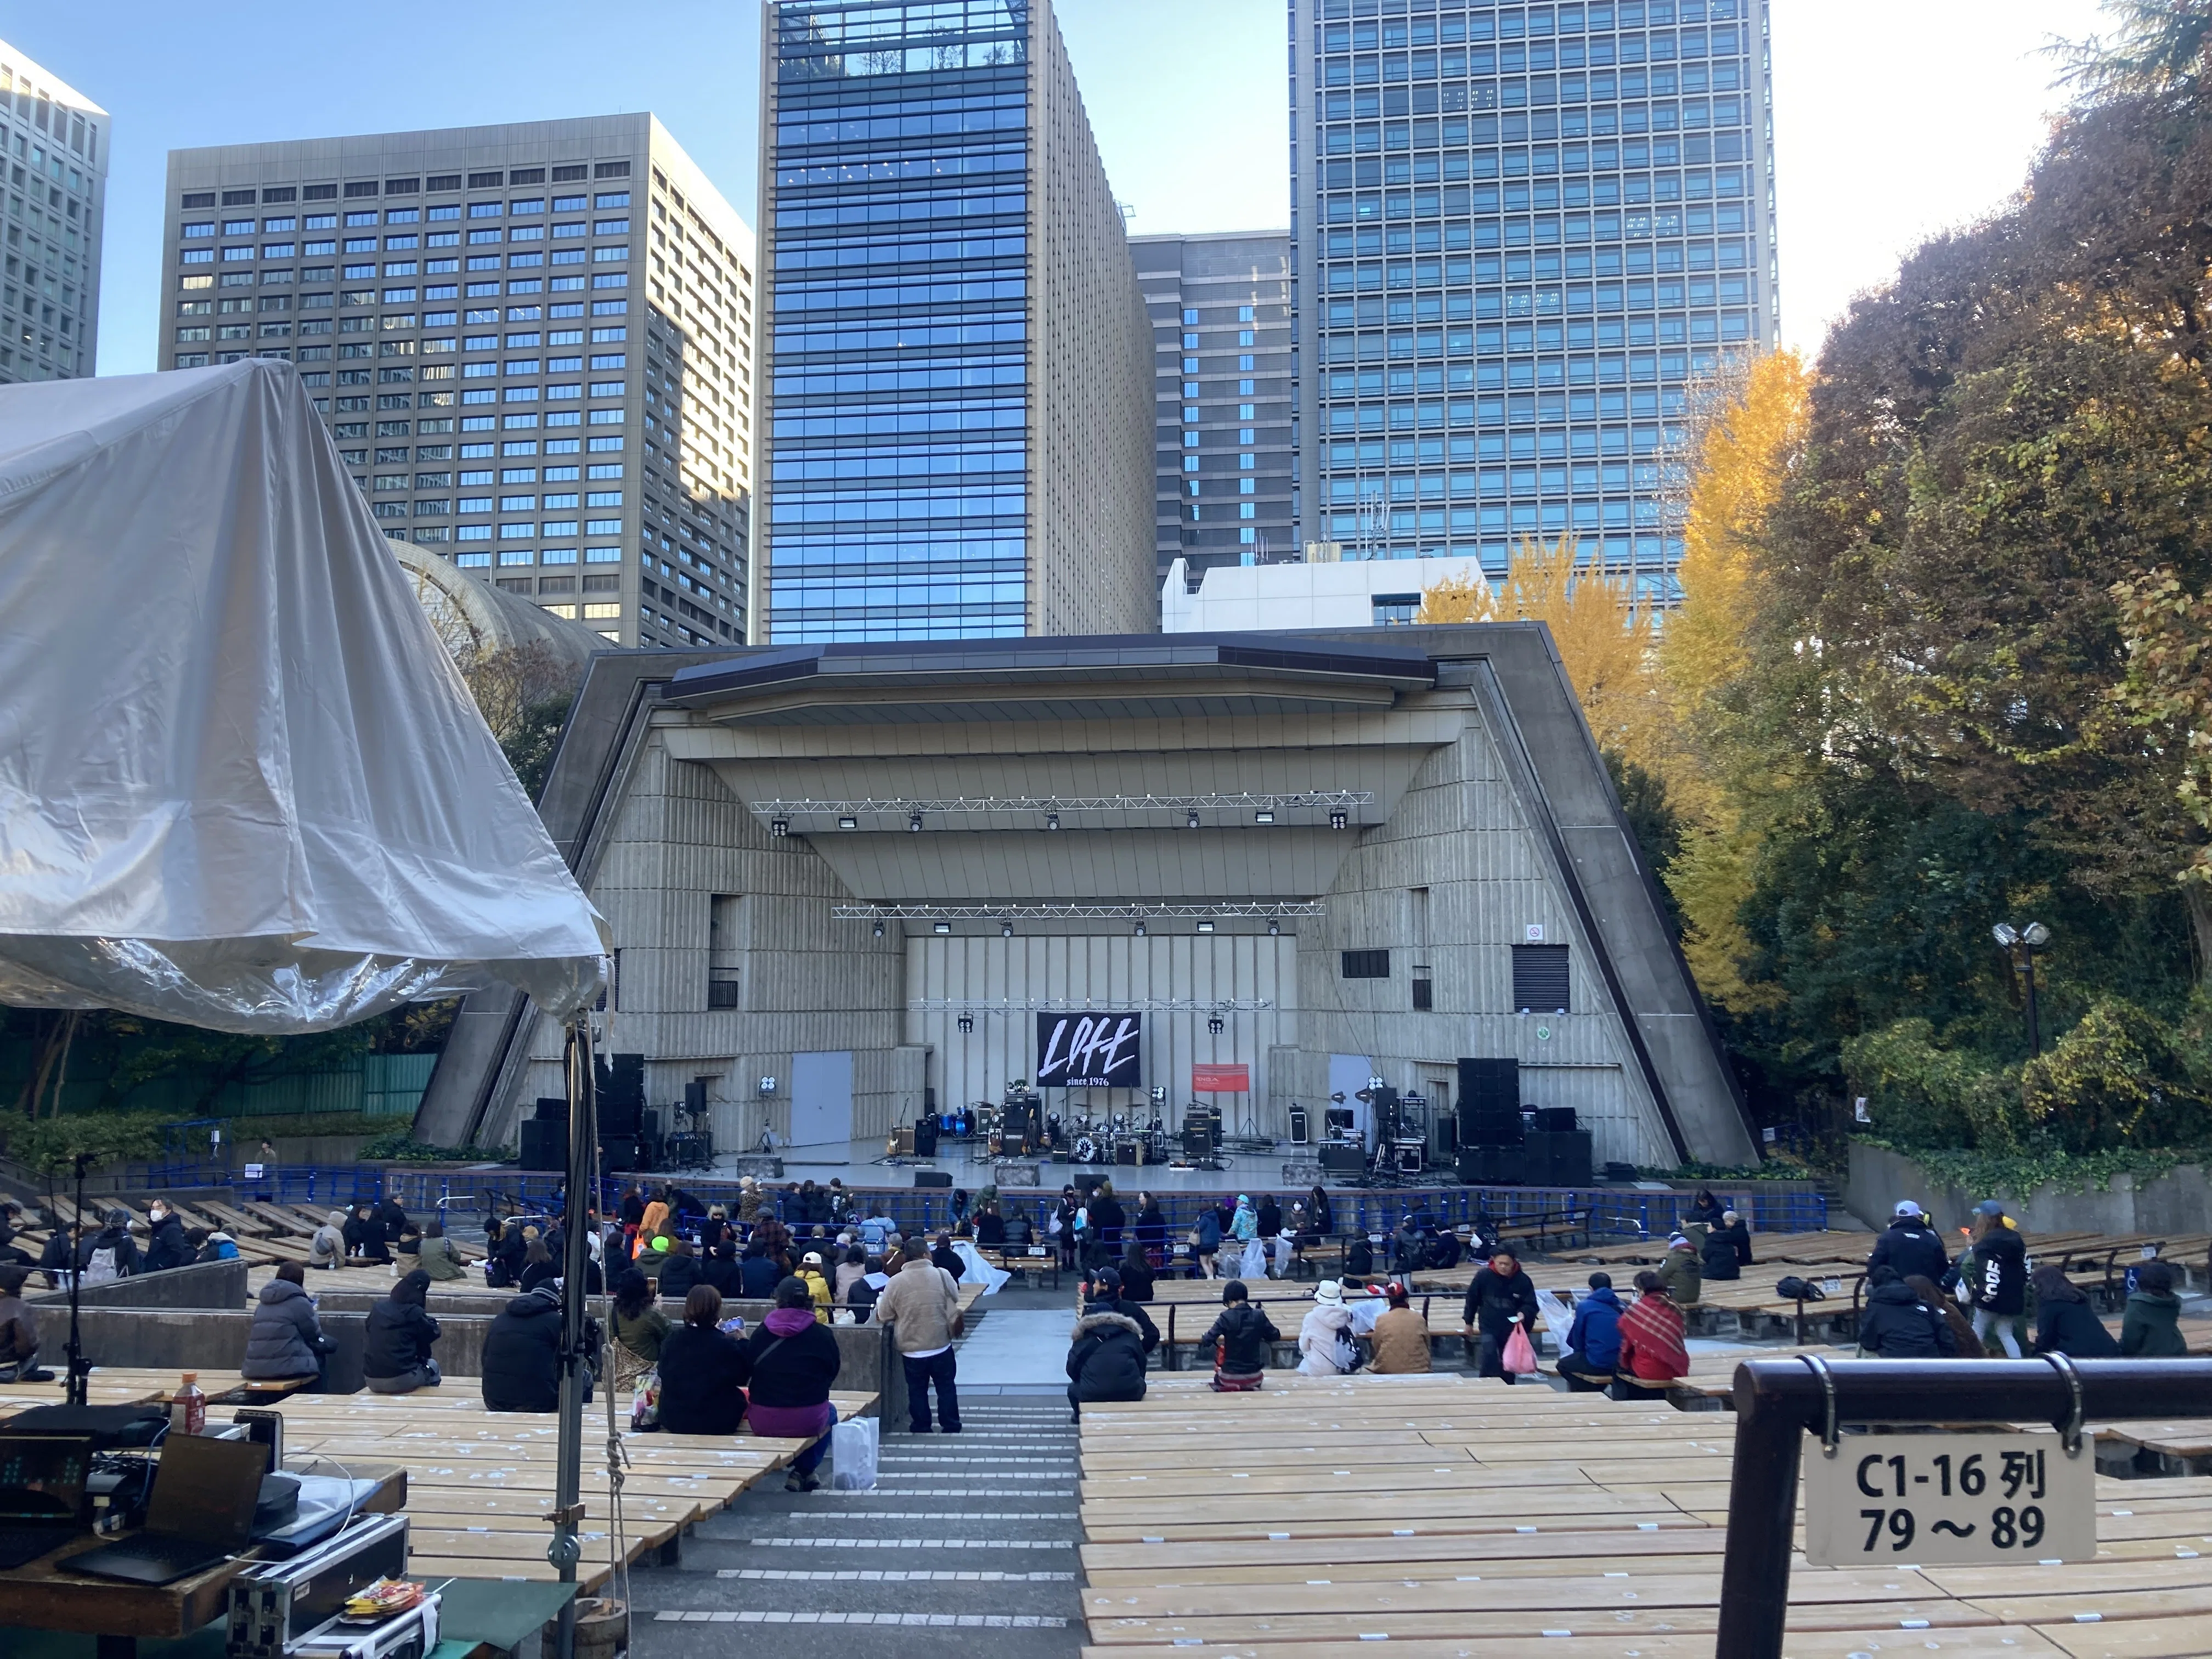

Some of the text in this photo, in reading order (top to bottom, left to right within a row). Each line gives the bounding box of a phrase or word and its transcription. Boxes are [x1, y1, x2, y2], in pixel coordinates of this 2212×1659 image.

[1066, 1077, 1109, 1086] since 1976
[1857, 1449, 2045, 1500] C1-16 列
[1860, 1508, 1916, 1551] 79
[1991, 1506, 2045, 1549] 89
